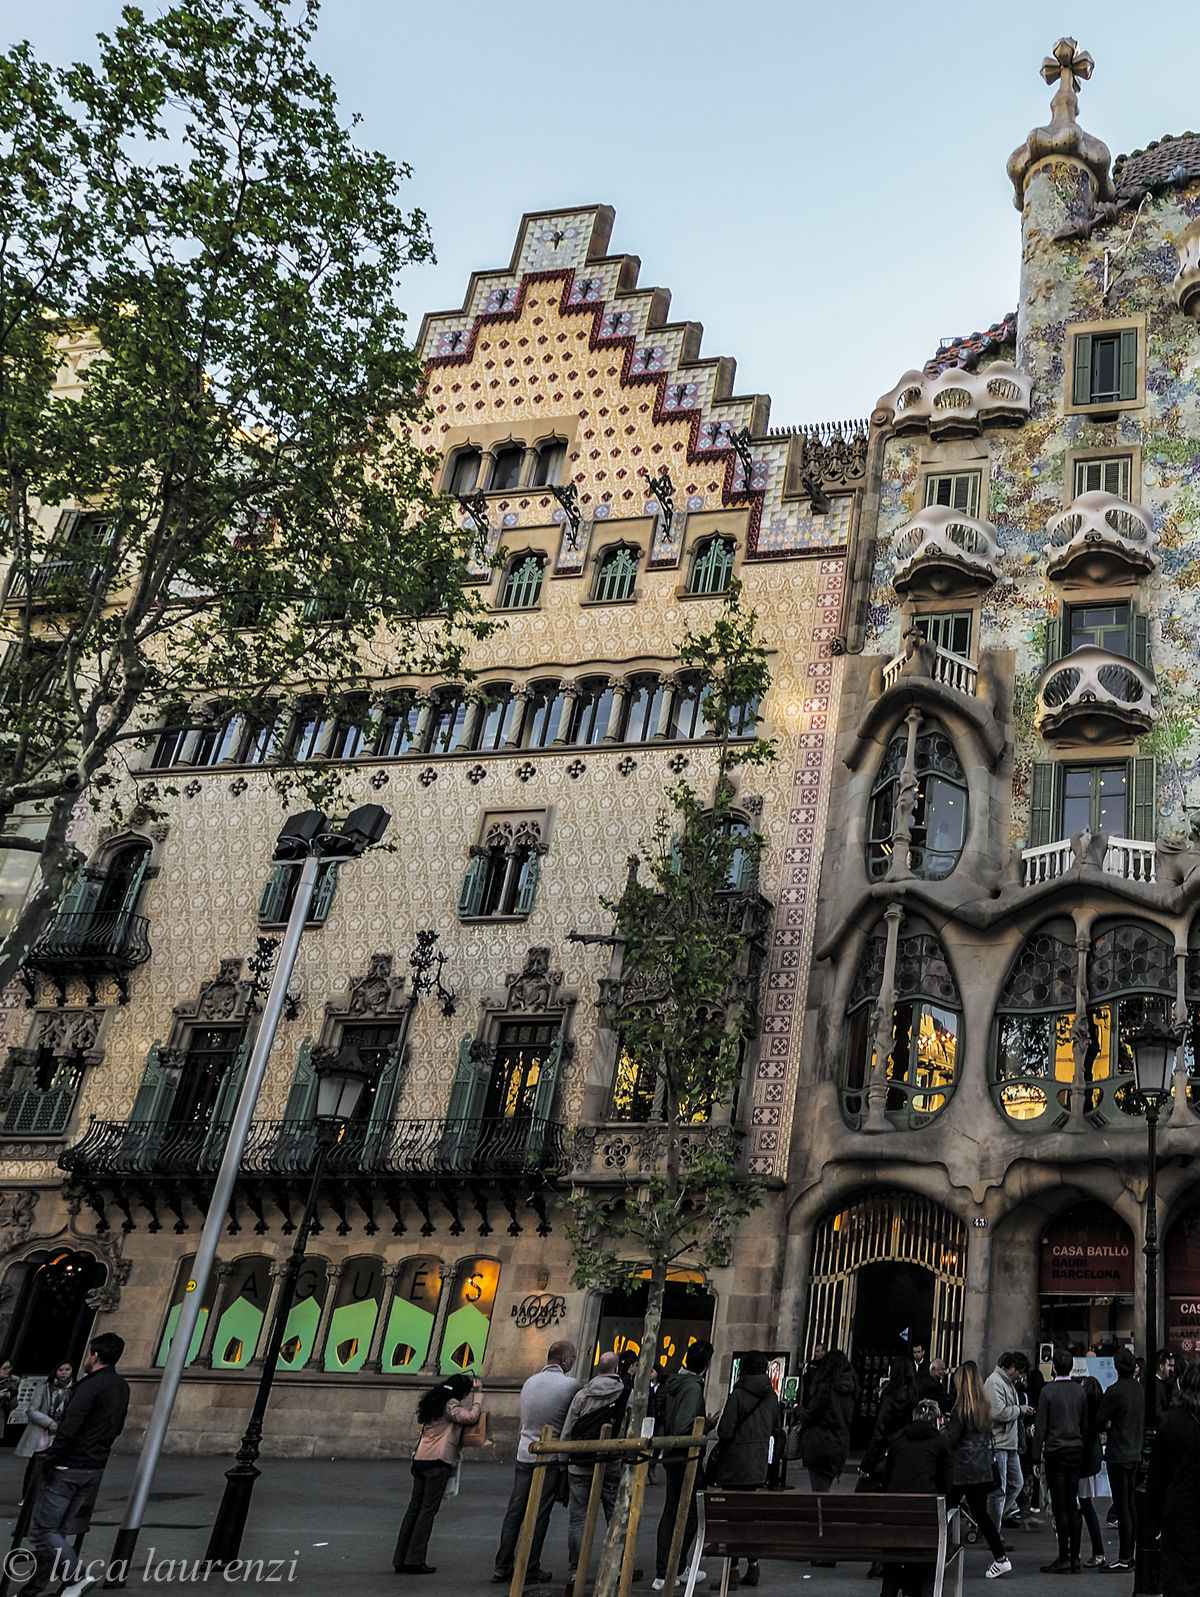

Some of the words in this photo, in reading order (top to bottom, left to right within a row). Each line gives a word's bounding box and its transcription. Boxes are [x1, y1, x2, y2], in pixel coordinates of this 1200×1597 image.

[1052, 1246, 1083, 1256] CASA
[1087, 1244, 1129, 1256] BATLLÓ
[1052, 1270, 1120, 1279] BARCELONA
[239, 1262, 484, 1303] AGUÉS
